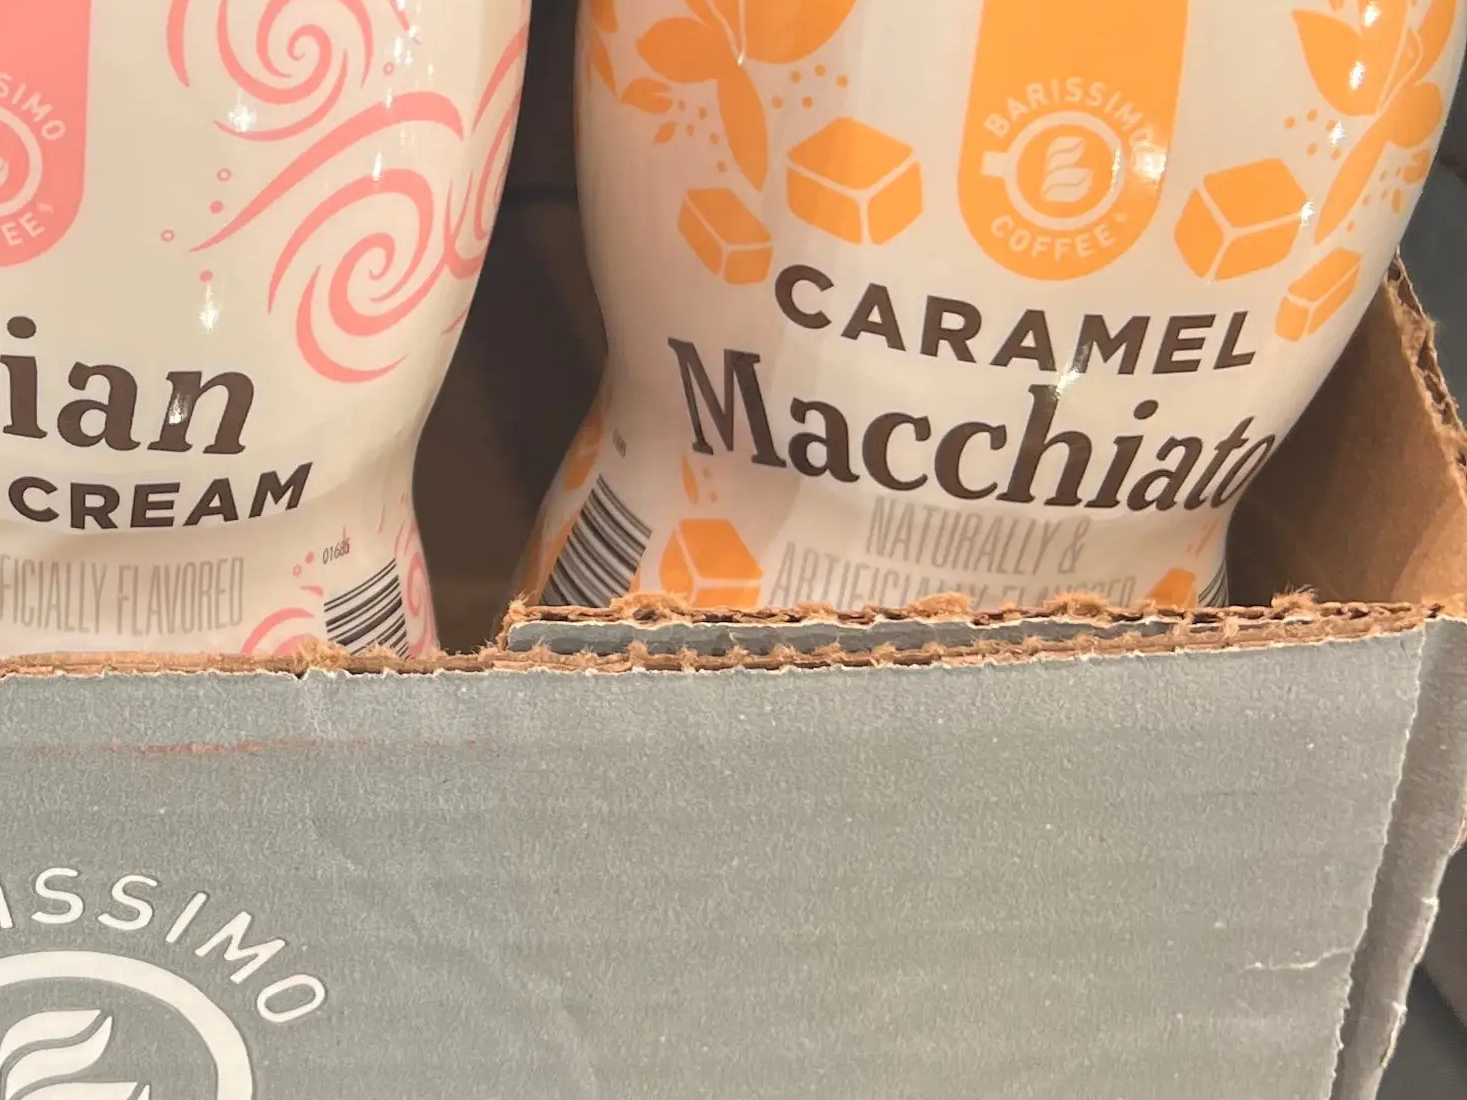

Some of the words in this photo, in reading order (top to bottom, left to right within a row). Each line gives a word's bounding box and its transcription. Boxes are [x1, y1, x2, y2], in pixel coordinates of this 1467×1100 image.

[989, 214, 1118, 261] COFFEE
[774, 263, 1256, 375] CARAMEL
[667, 337, 1275, 512] Macchiato
[7, 461, 313, 531] CREAM
[866, 495, 1061, 577] NATURALLY
[1057, 517, 1091, 575] &
[115, 556, 246, 636] FLAVORED
